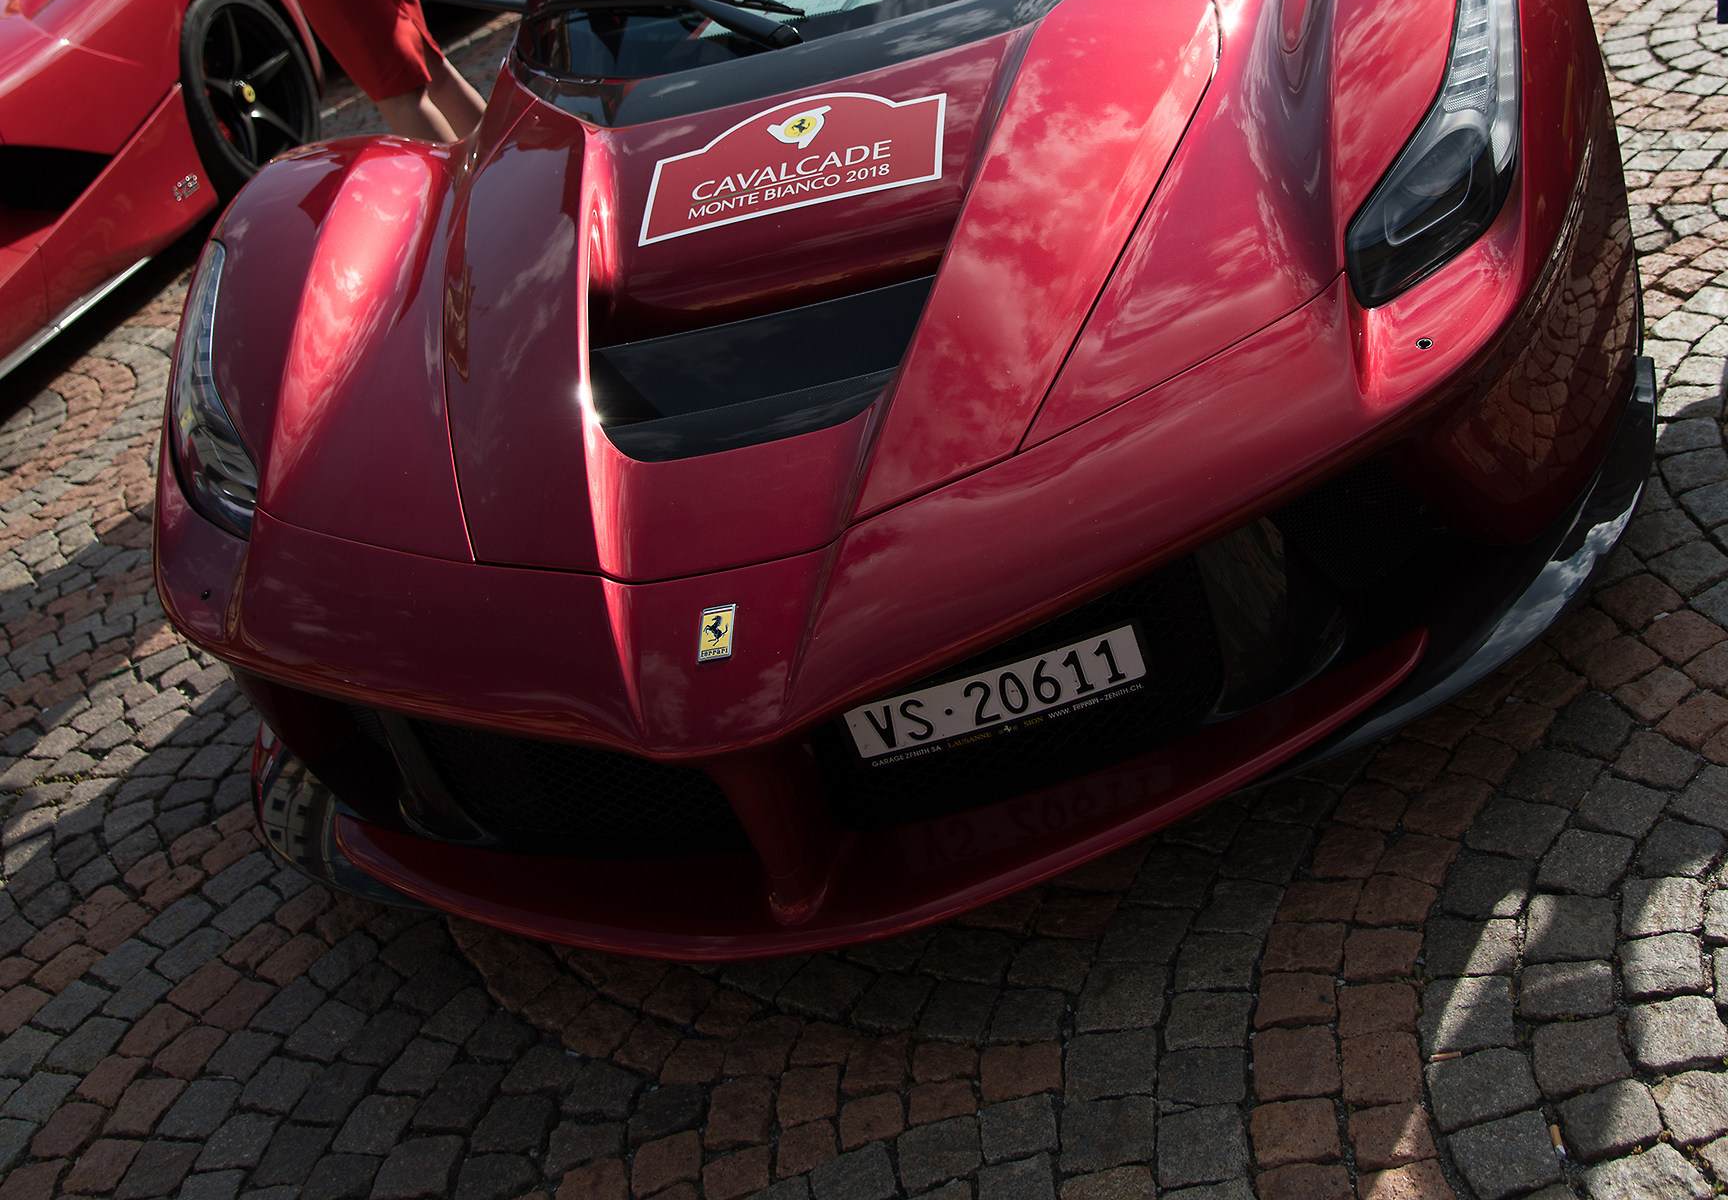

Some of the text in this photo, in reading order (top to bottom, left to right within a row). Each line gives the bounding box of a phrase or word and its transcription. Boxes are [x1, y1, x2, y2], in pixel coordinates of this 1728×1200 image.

[688, 163, 890, 220] MONTE BIANCO 2018
[690, 139, 893, 202] CAVALCADE
[871, 753, 905, 768] GARAGE
